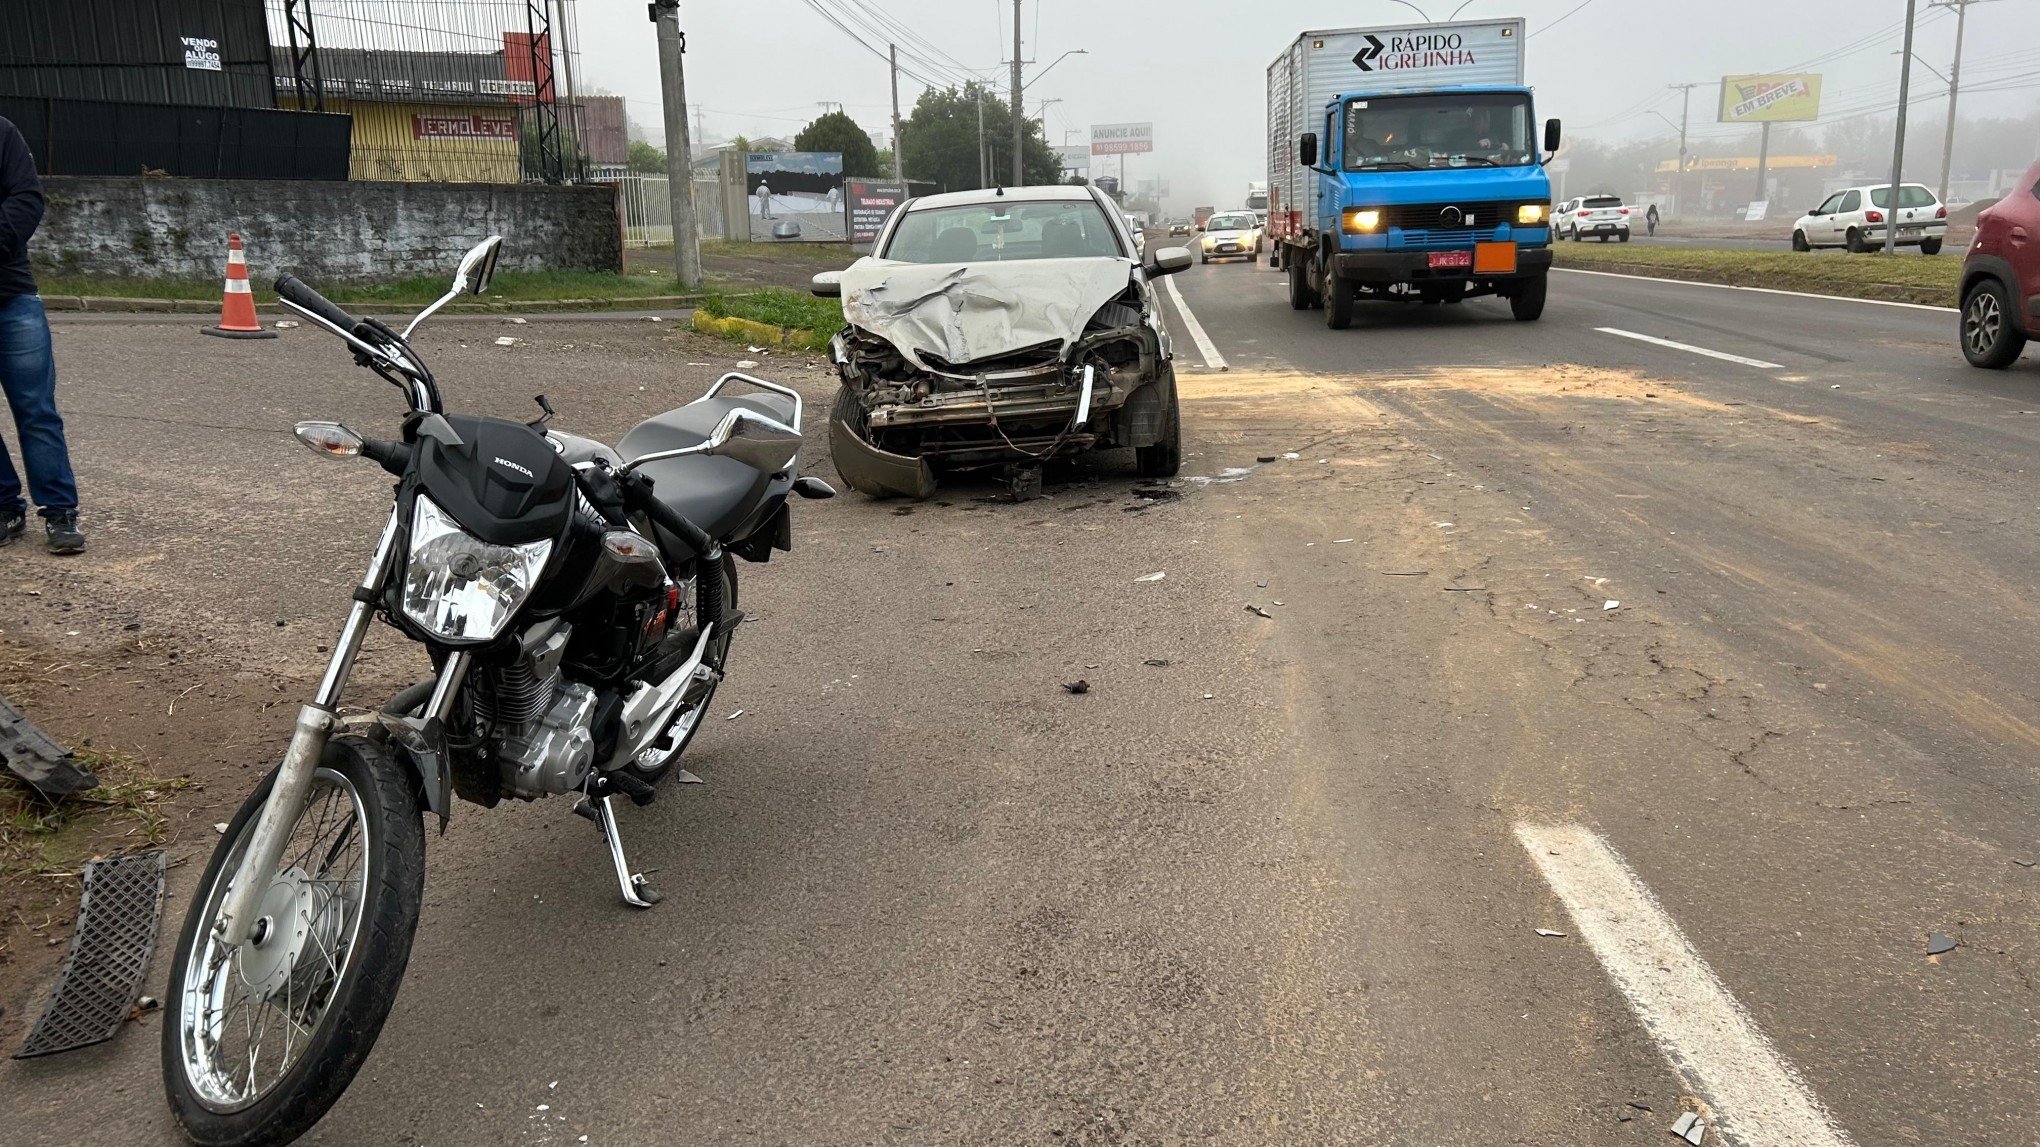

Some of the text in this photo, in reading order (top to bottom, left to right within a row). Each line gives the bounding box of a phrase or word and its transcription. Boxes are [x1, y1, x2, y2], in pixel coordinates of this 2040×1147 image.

[180, 36, 217, 48] VENDO
[1391, 32, 1462, 52] RÁPIDO
[185, 50, 220, 61] ALUGO
[1379, 50, 1475, 70] IGREJINHA
[1735, 101, 1755, 116] EM
[1758, 81, 1798, 106] BREVE
[1093, 128, 1128, 140] ANUNCIE
[494, 456, 534, 478] HONDA
